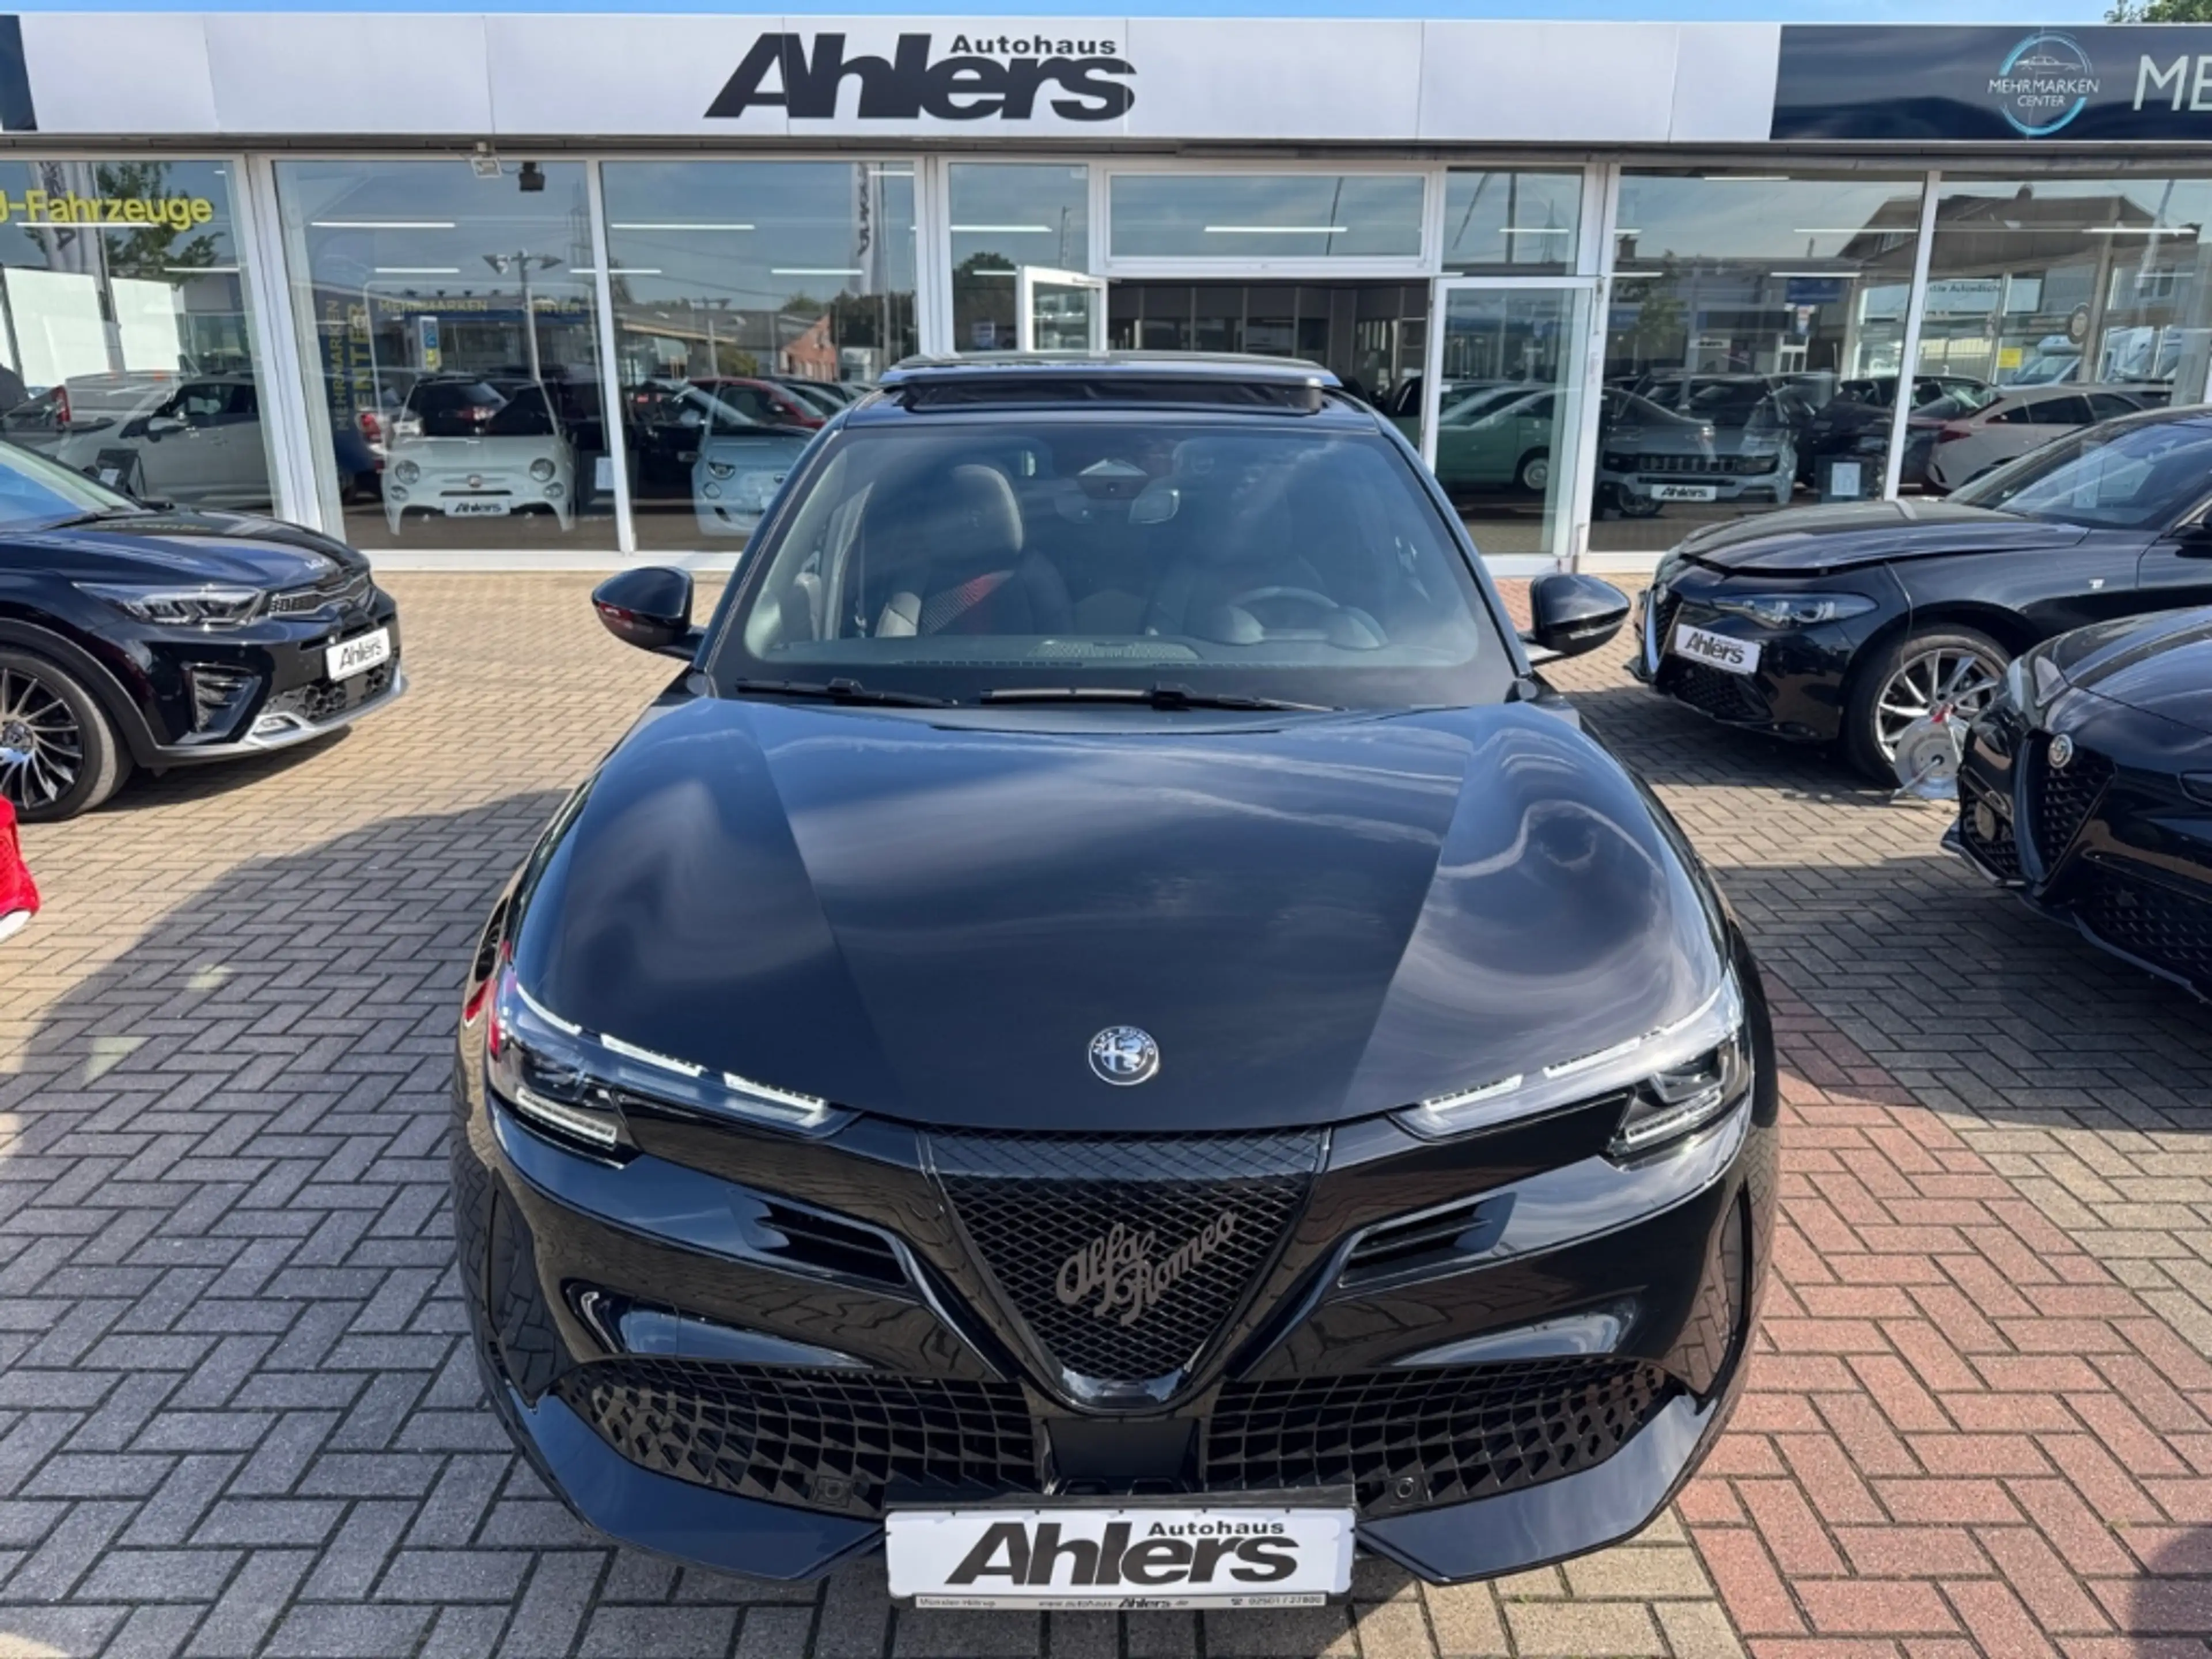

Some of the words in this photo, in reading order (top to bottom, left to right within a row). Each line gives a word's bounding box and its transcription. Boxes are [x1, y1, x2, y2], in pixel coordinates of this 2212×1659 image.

[950, 35, 1116, 55] Autohaus
[703, 33, 1137, 122] Ahlers
[1987, 78, 2100, 94] MEHRMARKEN
[2017, 95, 2065, 107] CENTER
[339, 641, 382, 671] Ahlers
[1684, 631, 1745, 664] Ahlers
[1056, 1222, 1156, 1317] Alfa
[1113, 1211, 1238, 1326] Romeo
[1148, 1521, 1285, 1537] Autohaus
[944, 1522, 1300, 1586] Ahlers
